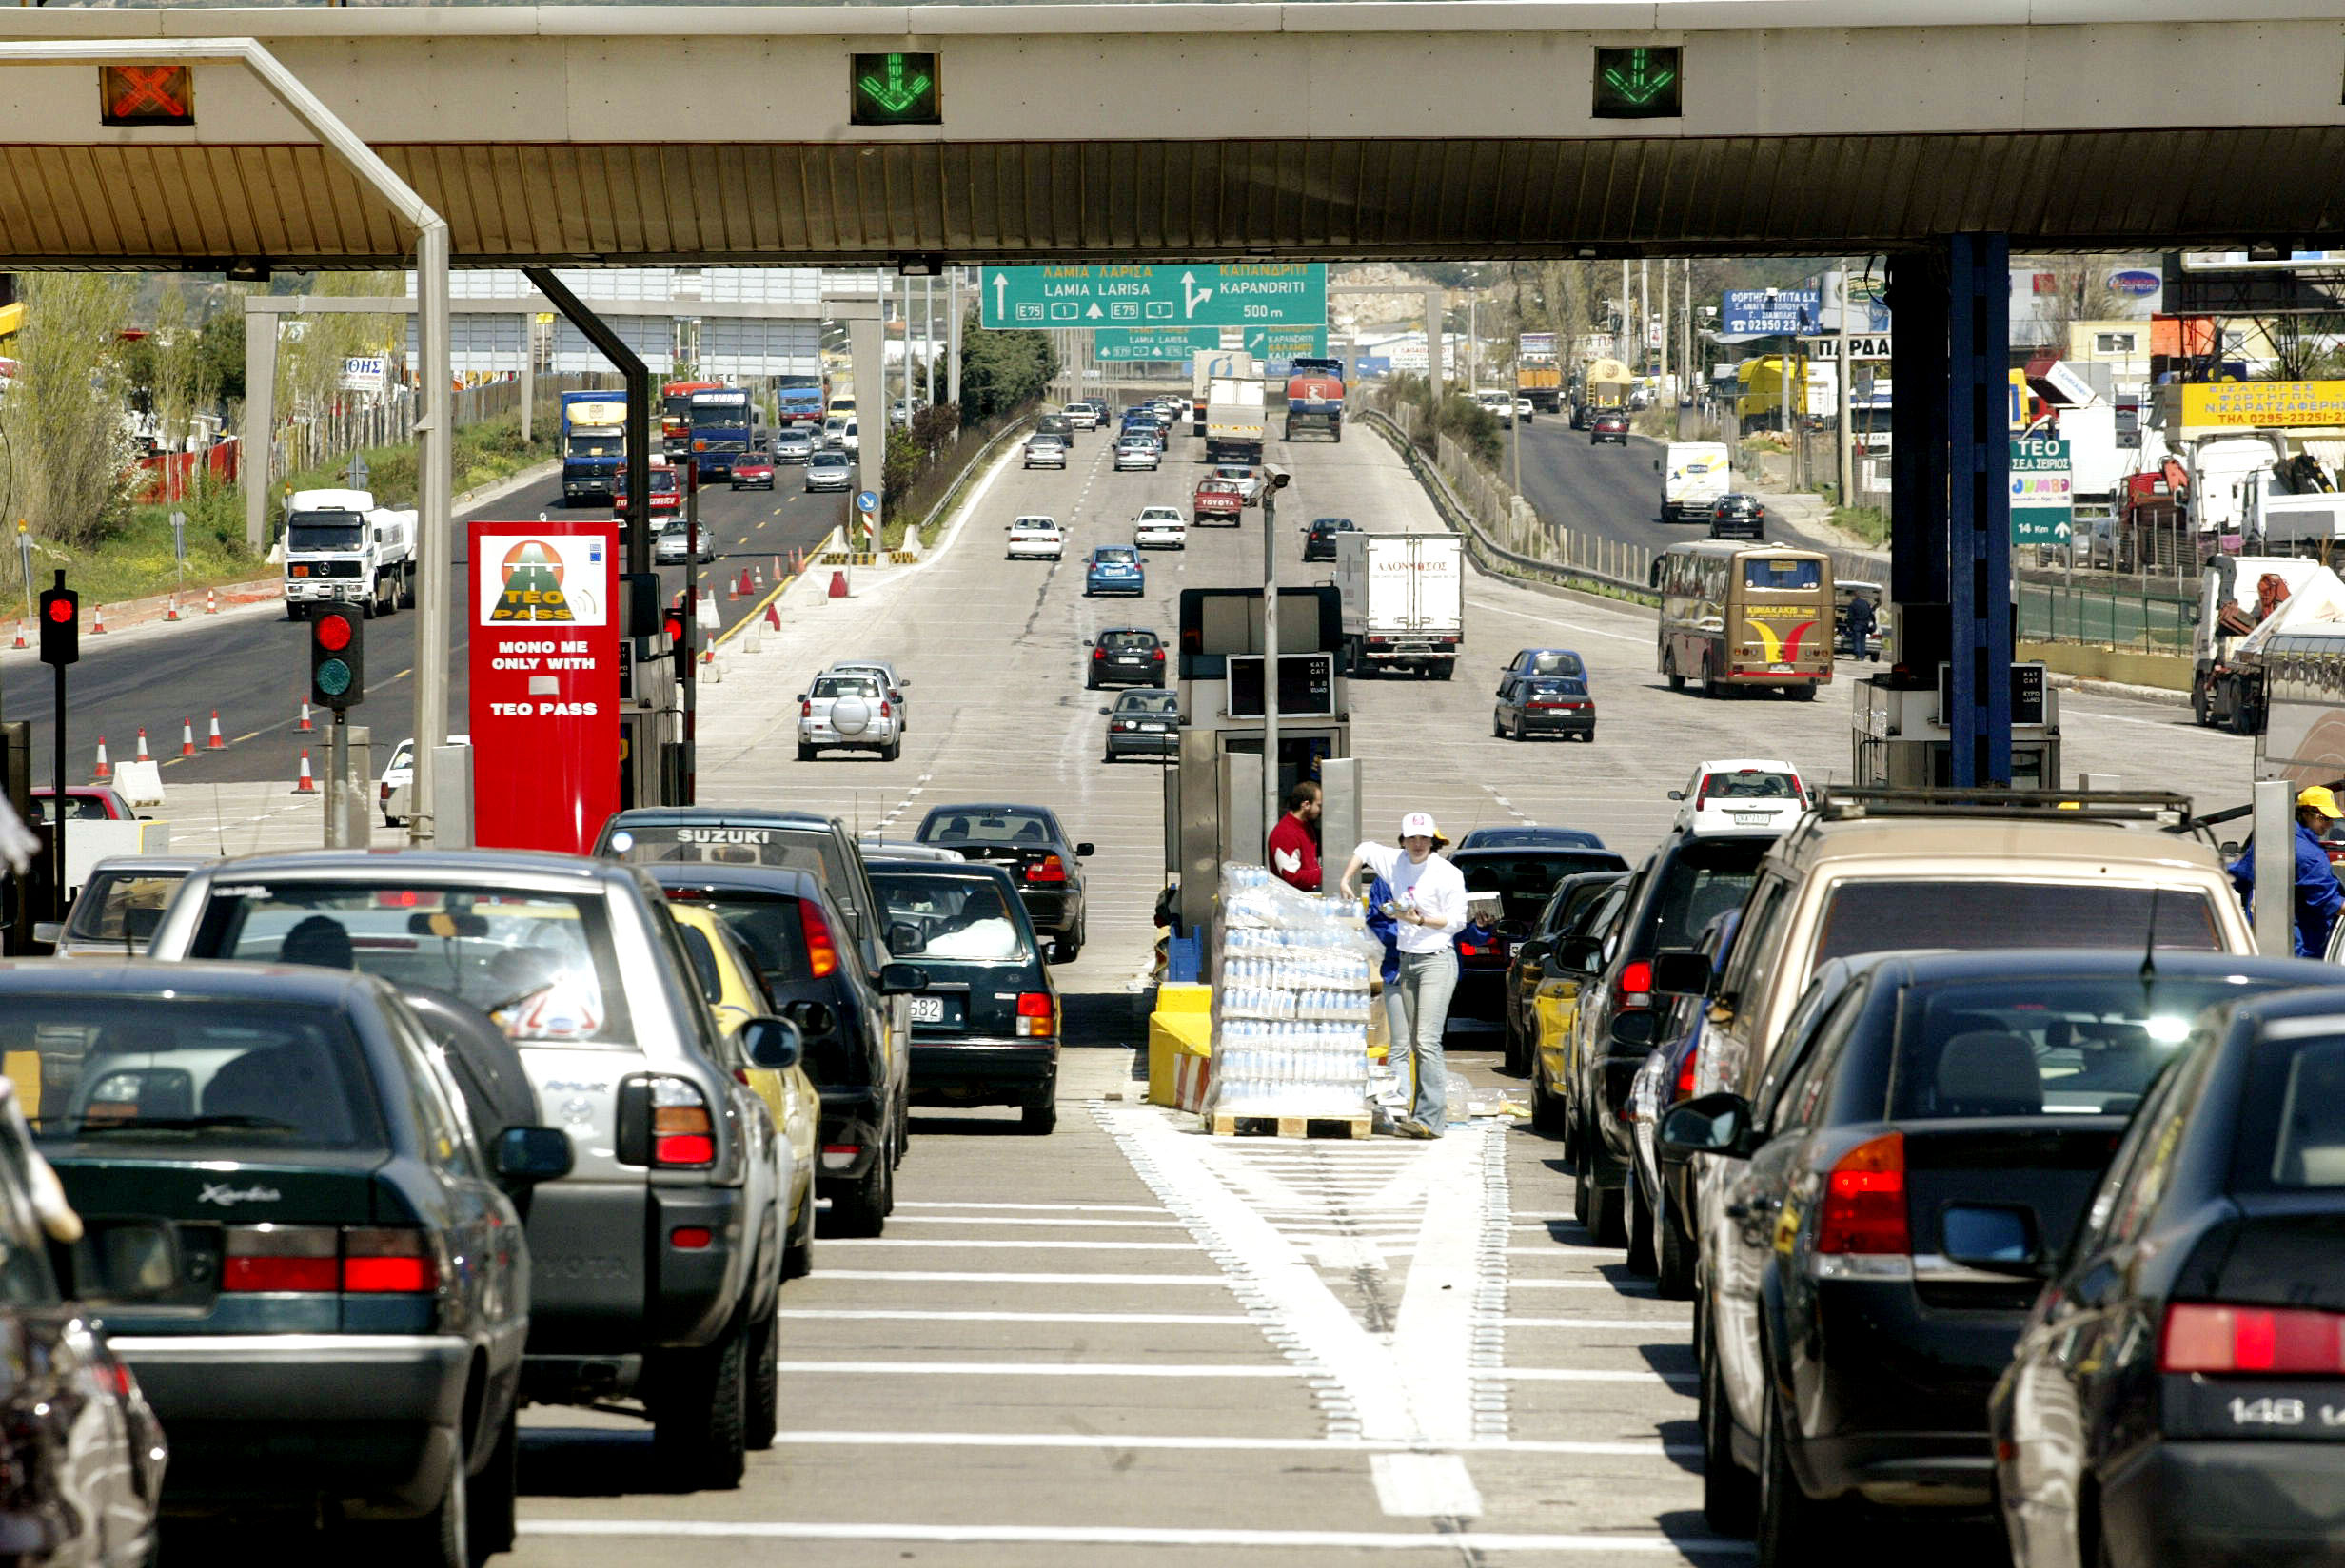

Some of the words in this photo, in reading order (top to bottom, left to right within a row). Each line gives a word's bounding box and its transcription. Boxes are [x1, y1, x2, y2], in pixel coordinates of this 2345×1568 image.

[1043, 265, 1090, 278] ΛΑΜΙΑ
[1099, 265, 1153, 278] ΛΑΡΙΣΑ
[1220, 265, 1308, 276] ΚΑΠΑΝΔΡΙΤΙ
[1044, 284, 1090, 297] LAMIA
[1098, 283, 1151, 296] LARISA
[1219, 281, 1306, 294] KAPANDRITI
[1243, 304, 1268, 318] 500
[1271, 309, 1283, 318] m
[1748, 319, 1781, 332] 02950
[2011, 478, 2070, 494] JUMBO
[2018, 522, 2032, 534] 14
[503, 590, 564, 604] TEO
[493, 609, 574, 620] PASS
[491, 657, 541, 671] ONLY
[547, 657, 596, 671] WITH
[490, 703, 533, 716] TEO
[540, 702, 598, 715] PASS
[677, 829, 770, 844] SUZUKI
